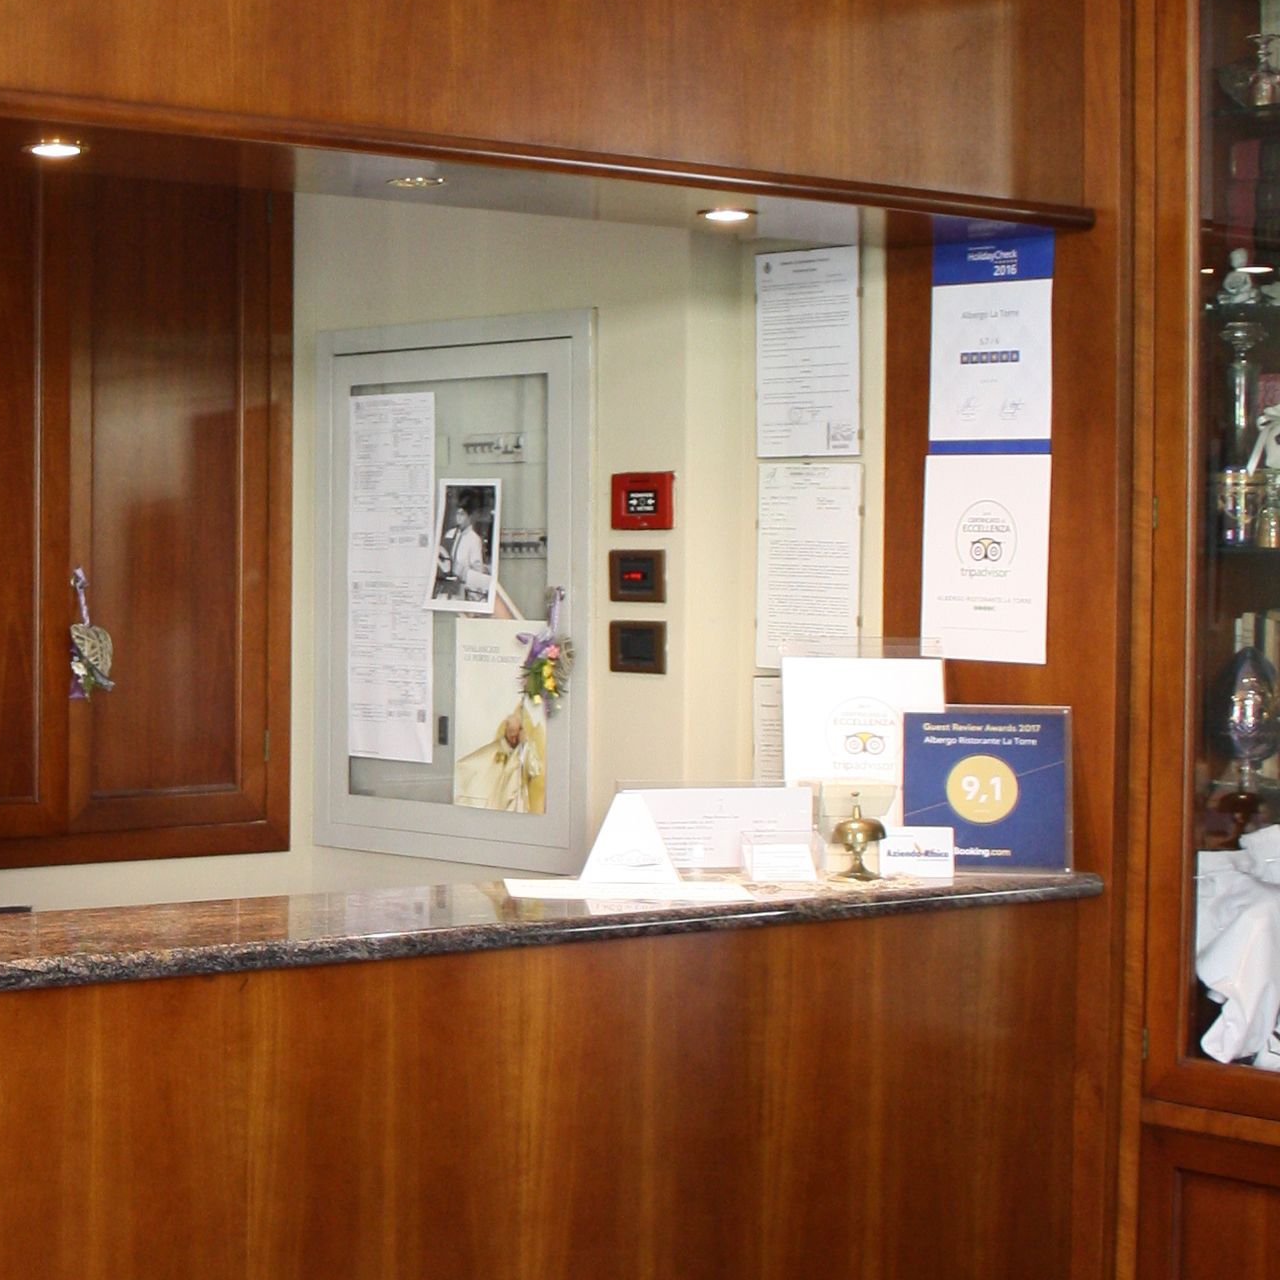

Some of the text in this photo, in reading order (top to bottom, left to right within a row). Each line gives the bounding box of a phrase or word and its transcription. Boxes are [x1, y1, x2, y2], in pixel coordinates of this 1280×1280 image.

[967, 249, 1018, 262] HolidayCheck
[993, 264, 1017, 276] 2016
[962, 524, 1011, 533] ECCELLENZA
[923, 723, 1041, 733] Guest Review Awards 2017
[923, 736, 1038, 746] Albergo Ristorante La Torre
[961, 775, 1002, 803] 9,1
